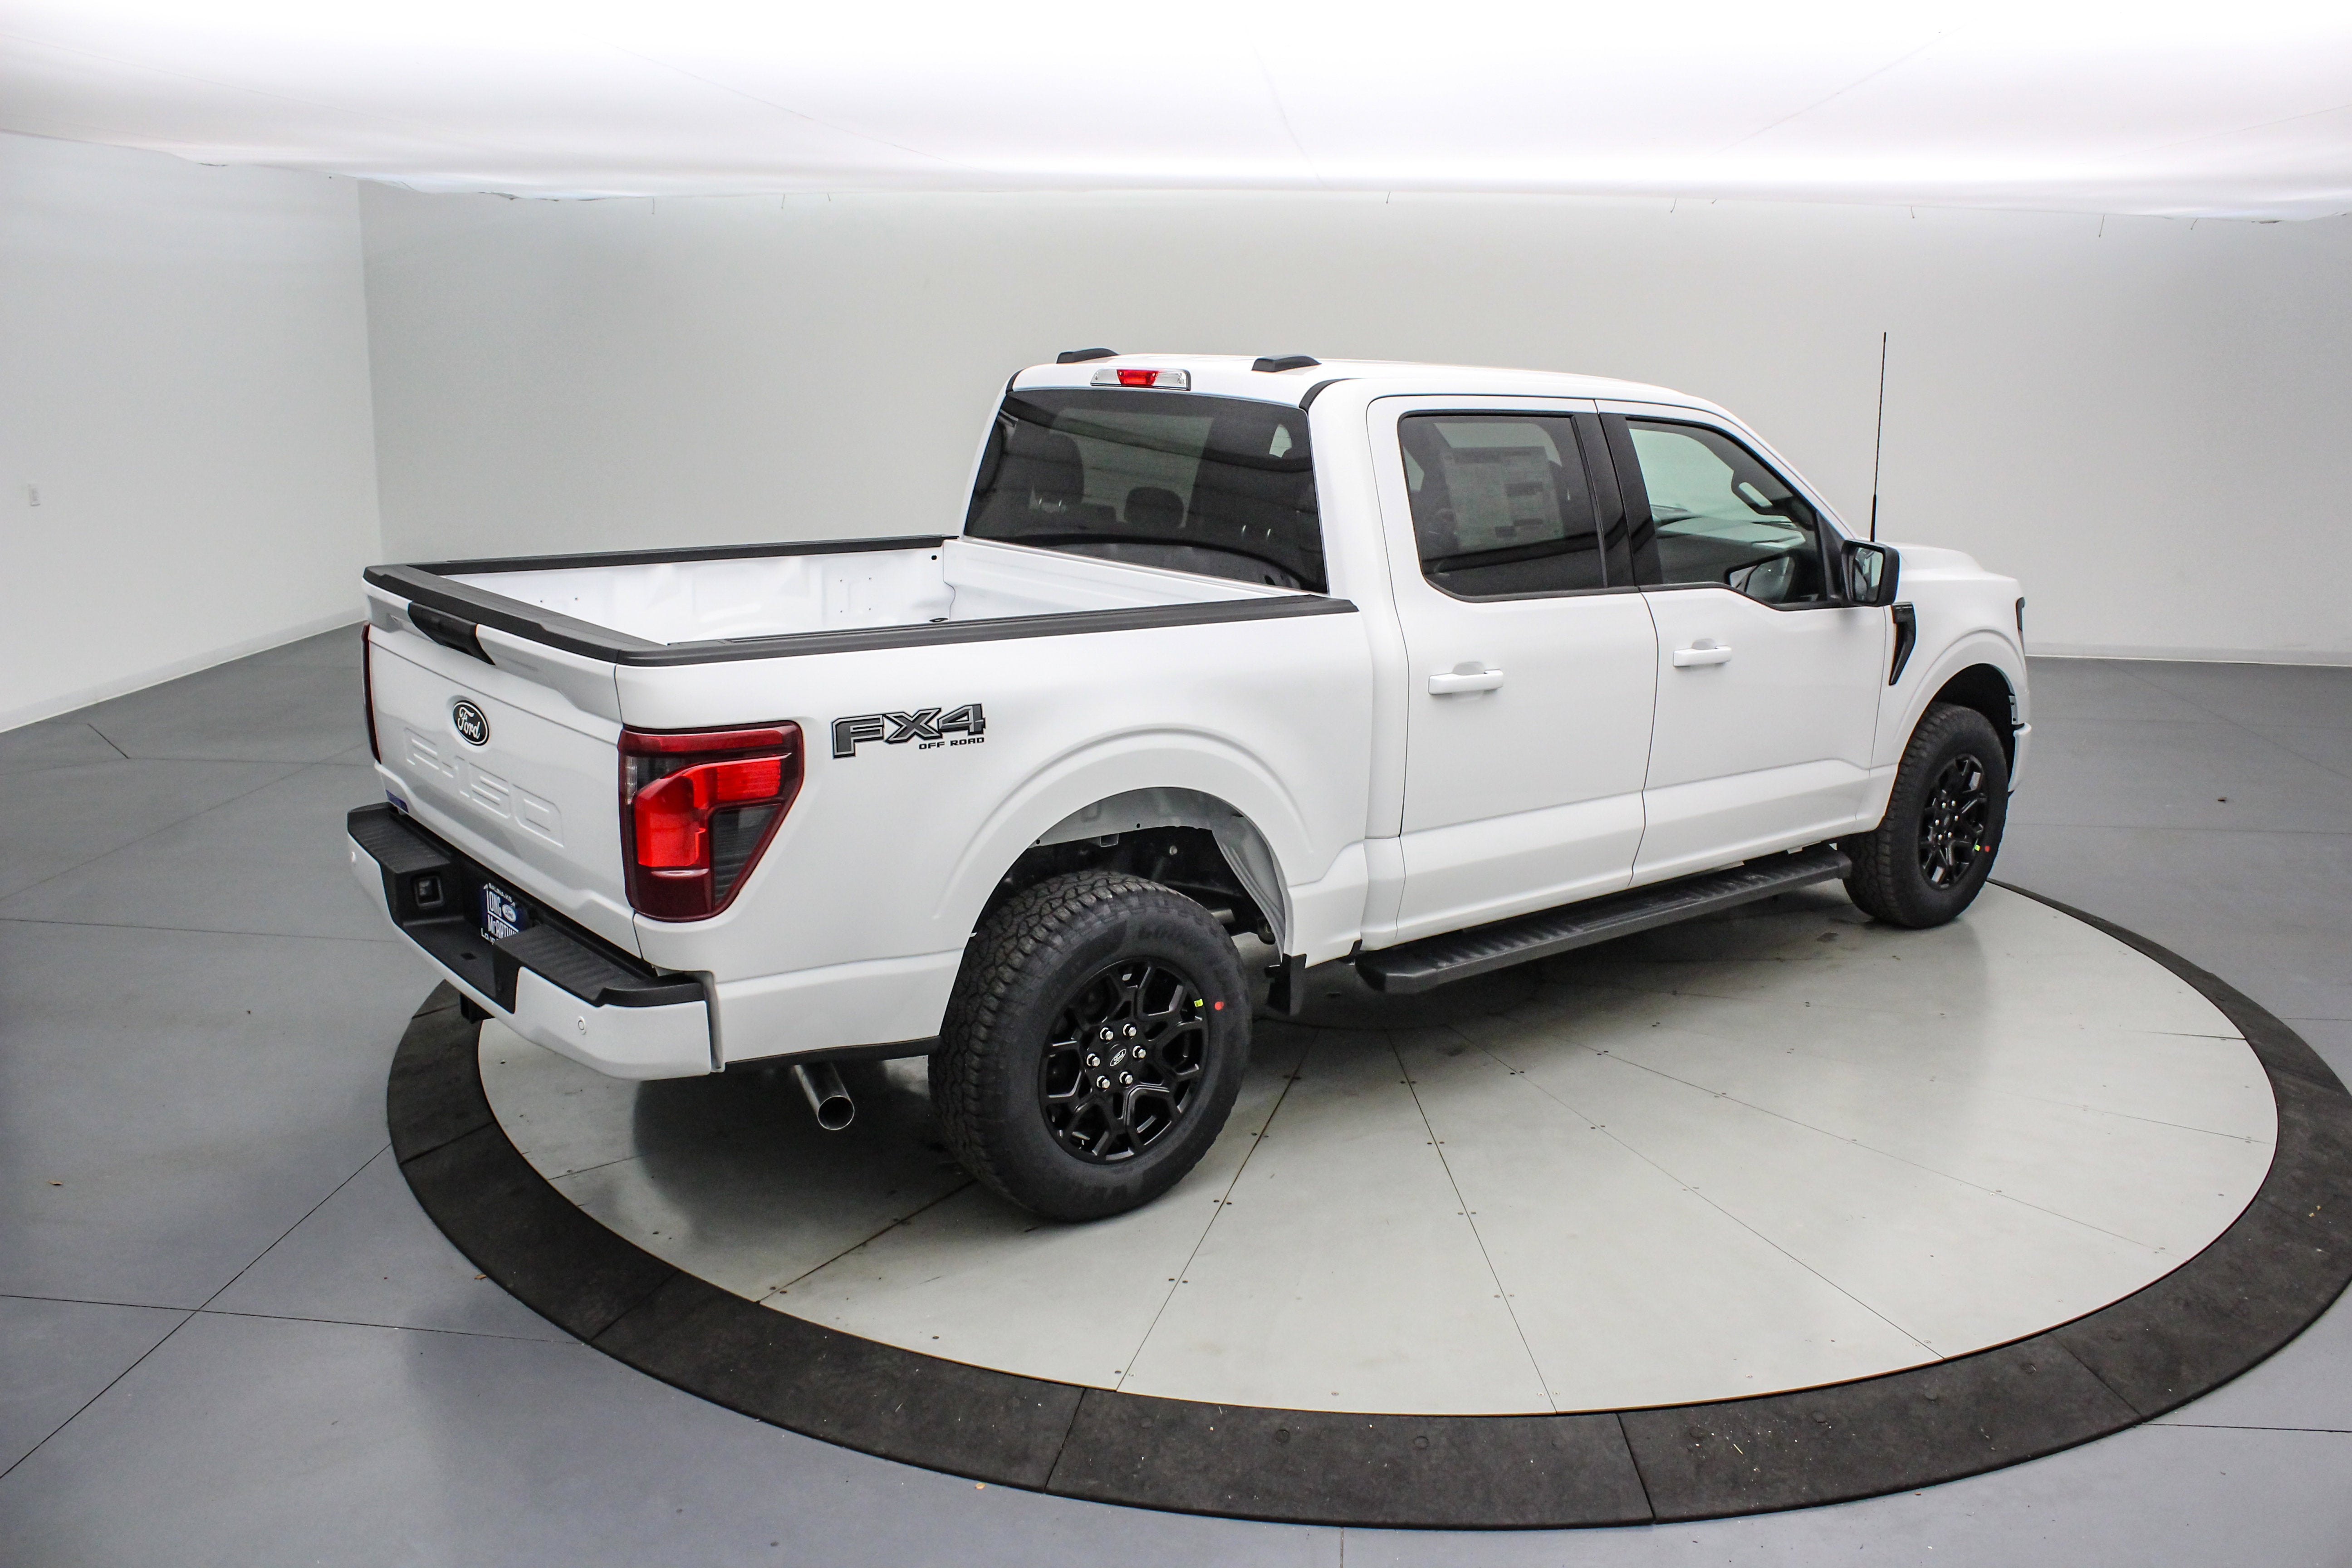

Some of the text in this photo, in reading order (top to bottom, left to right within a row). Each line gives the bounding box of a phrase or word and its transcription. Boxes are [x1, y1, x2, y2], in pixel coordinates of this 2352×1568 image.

[457, 706, 480, 740] Ford
[832, 703, 986, 759] FX4
[951, 737, 985, 746] ROAD
[403, 727, 564, 848] F-150
[486, 889, 502, 917] LONG
[488, 914, 517, 939] McART
